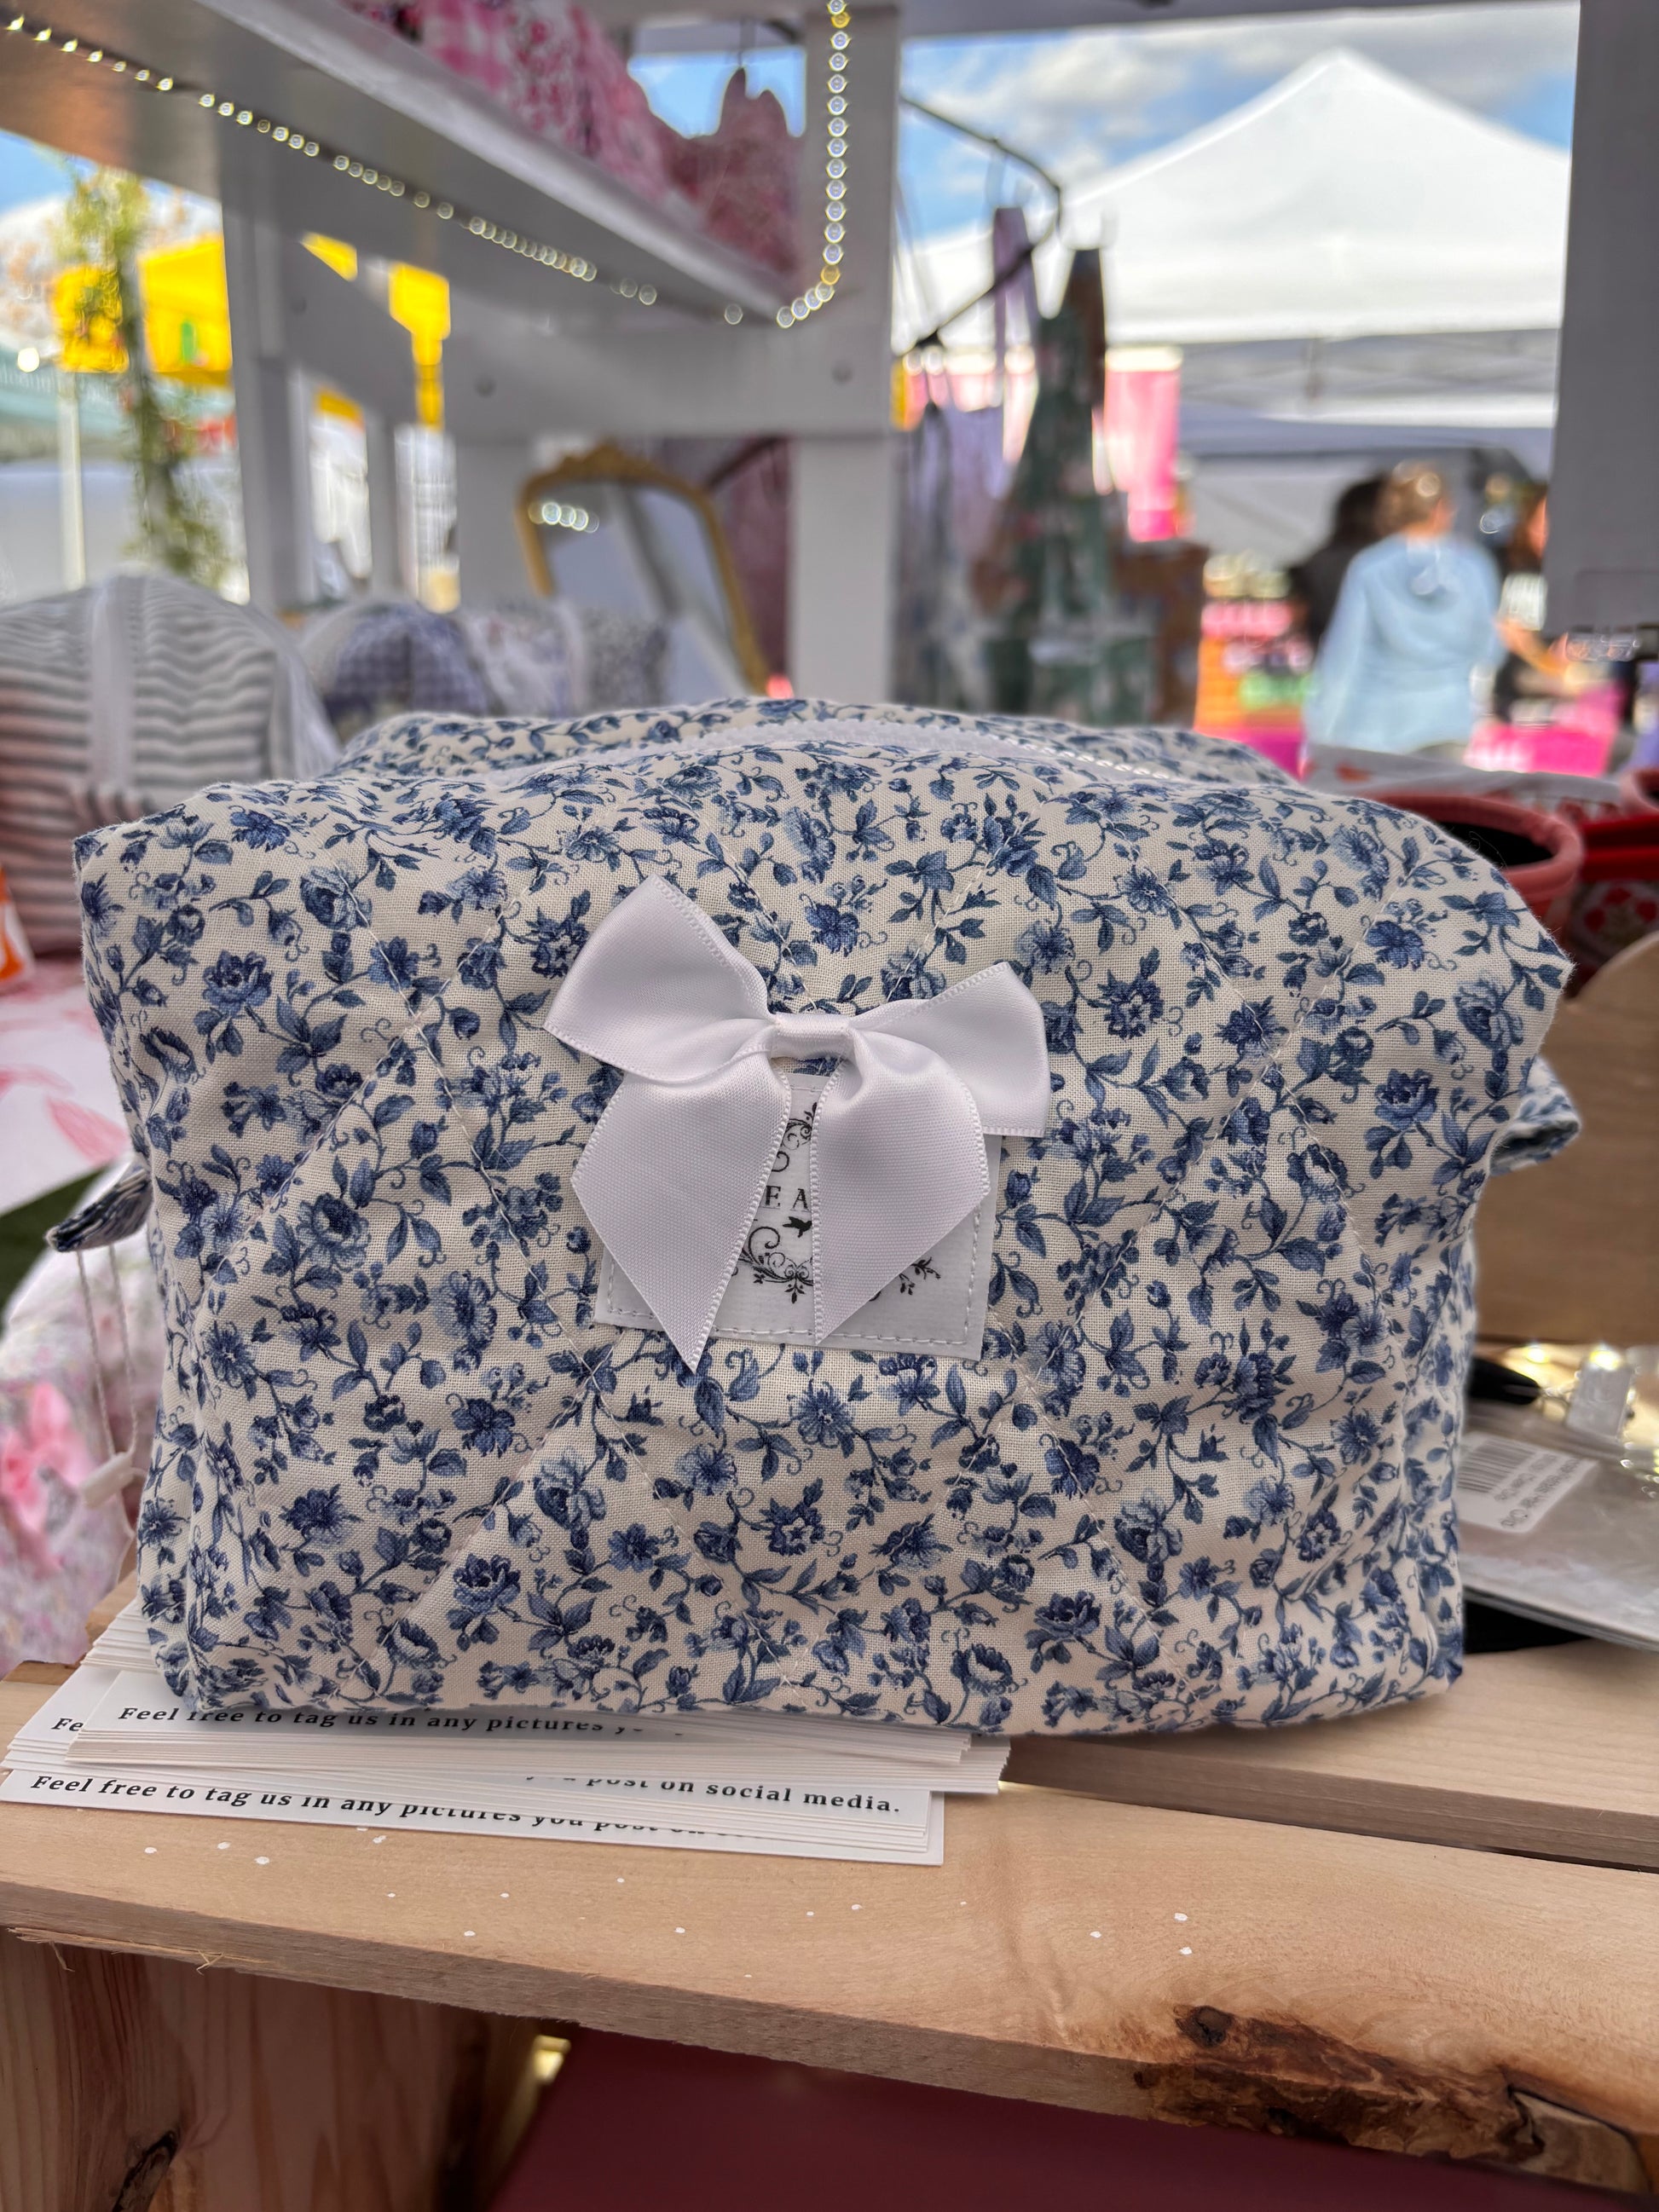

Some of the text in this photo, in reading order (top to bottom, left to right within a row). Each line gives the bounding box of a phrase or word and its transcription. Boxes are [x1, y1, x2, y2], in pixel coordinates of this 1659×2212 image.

[50, 1718, 84, 1732] Fe
[118, 1707, 179, 1721] Feel
[254, 1710, 283, 1724] to
[292, 1711, 338, 1728] tag
[347, 1713, 379, 1726] us
[388, 1712, 415, 1727] in
[427, 1716, 477, 1731] any
[485, 1715, 604, 1732] pictures
[30, 1775, 94, 1793] Feel
[98, 1779, 157, 1797] free
[166, 1785, 195, 1799] to
[205, 1788, 252, 1807] tag
[260, 1793, 292, 1806] us
[301, 1796, 331, 1809] in
[340, 1798, 393, 1816] any
[660, 1780, 695, 1793] on
[705, 1783, 792, 1802] social
[803, 1792, 900, 1813] media.
